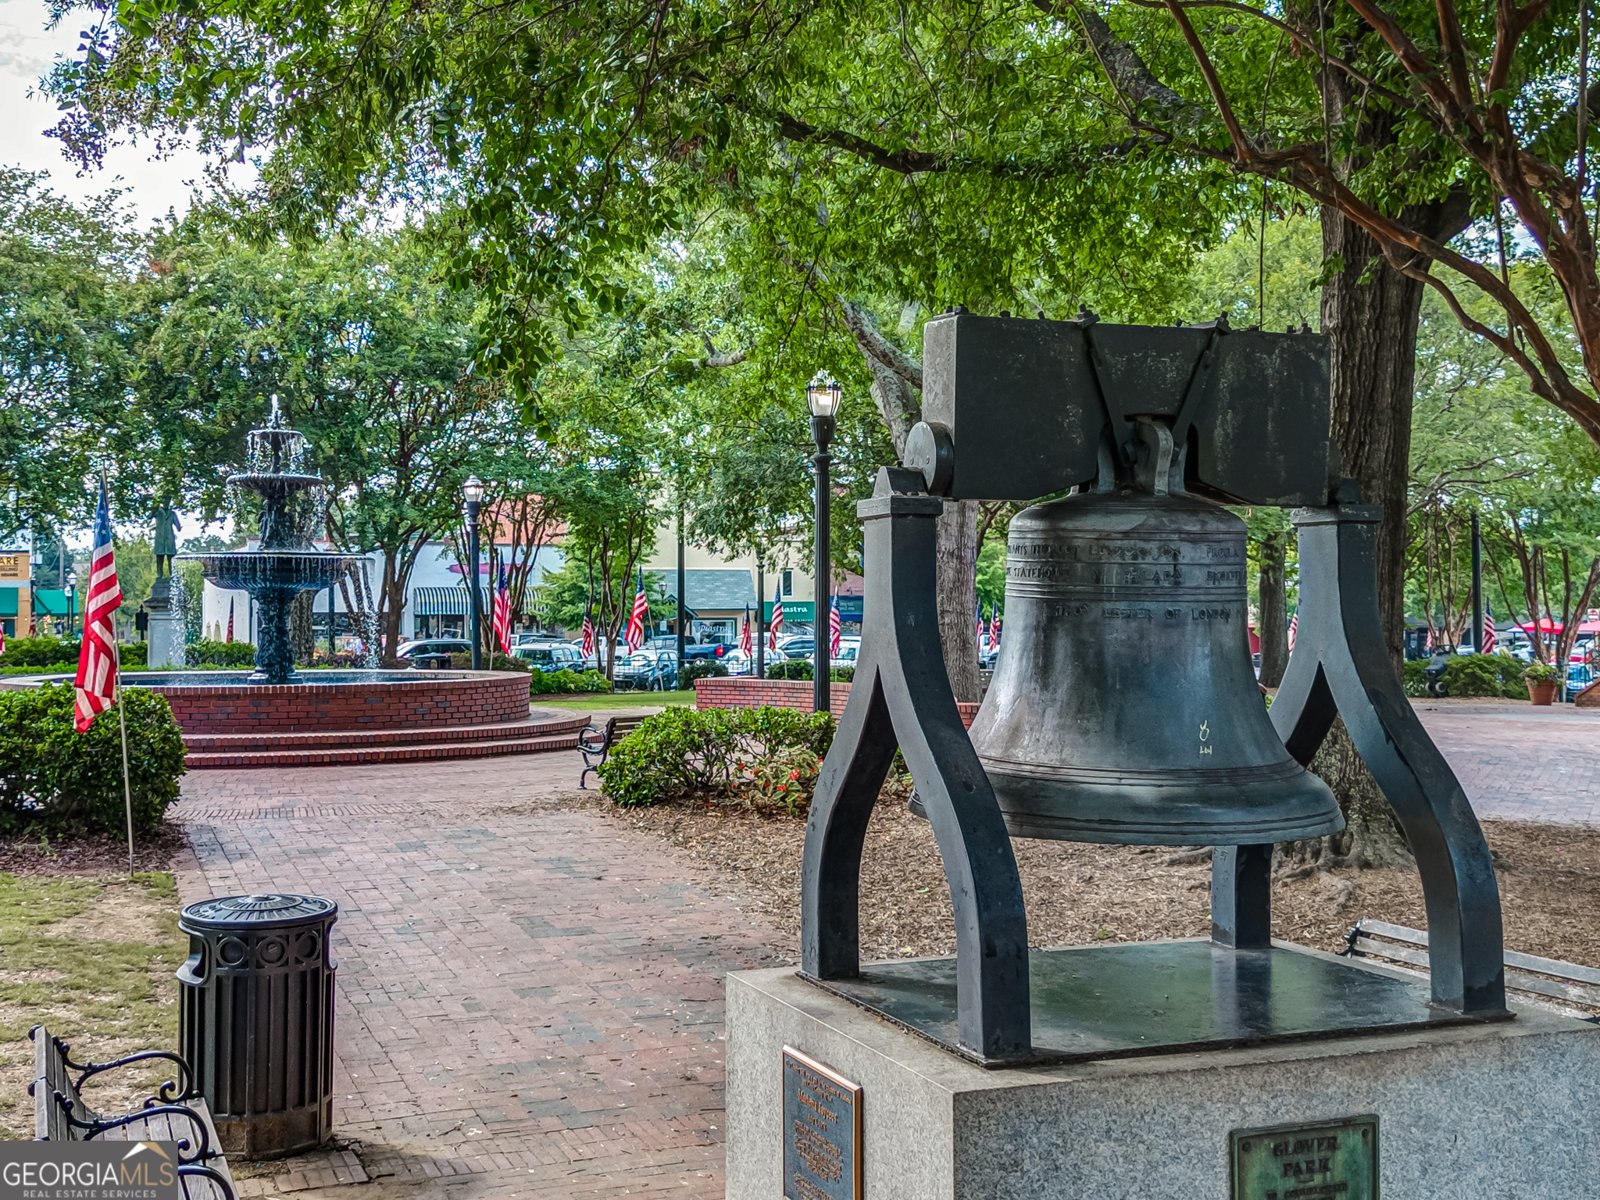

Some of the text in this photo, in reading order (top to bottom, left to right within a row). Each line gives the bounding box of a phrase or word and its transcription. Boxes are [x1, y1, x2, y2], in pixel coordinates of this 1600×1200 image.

[1164, 607, 1181, 620] OF
[1190, 607, 1231, 622] LONDON
[1282, 1157, 1331, 1178] PARK
